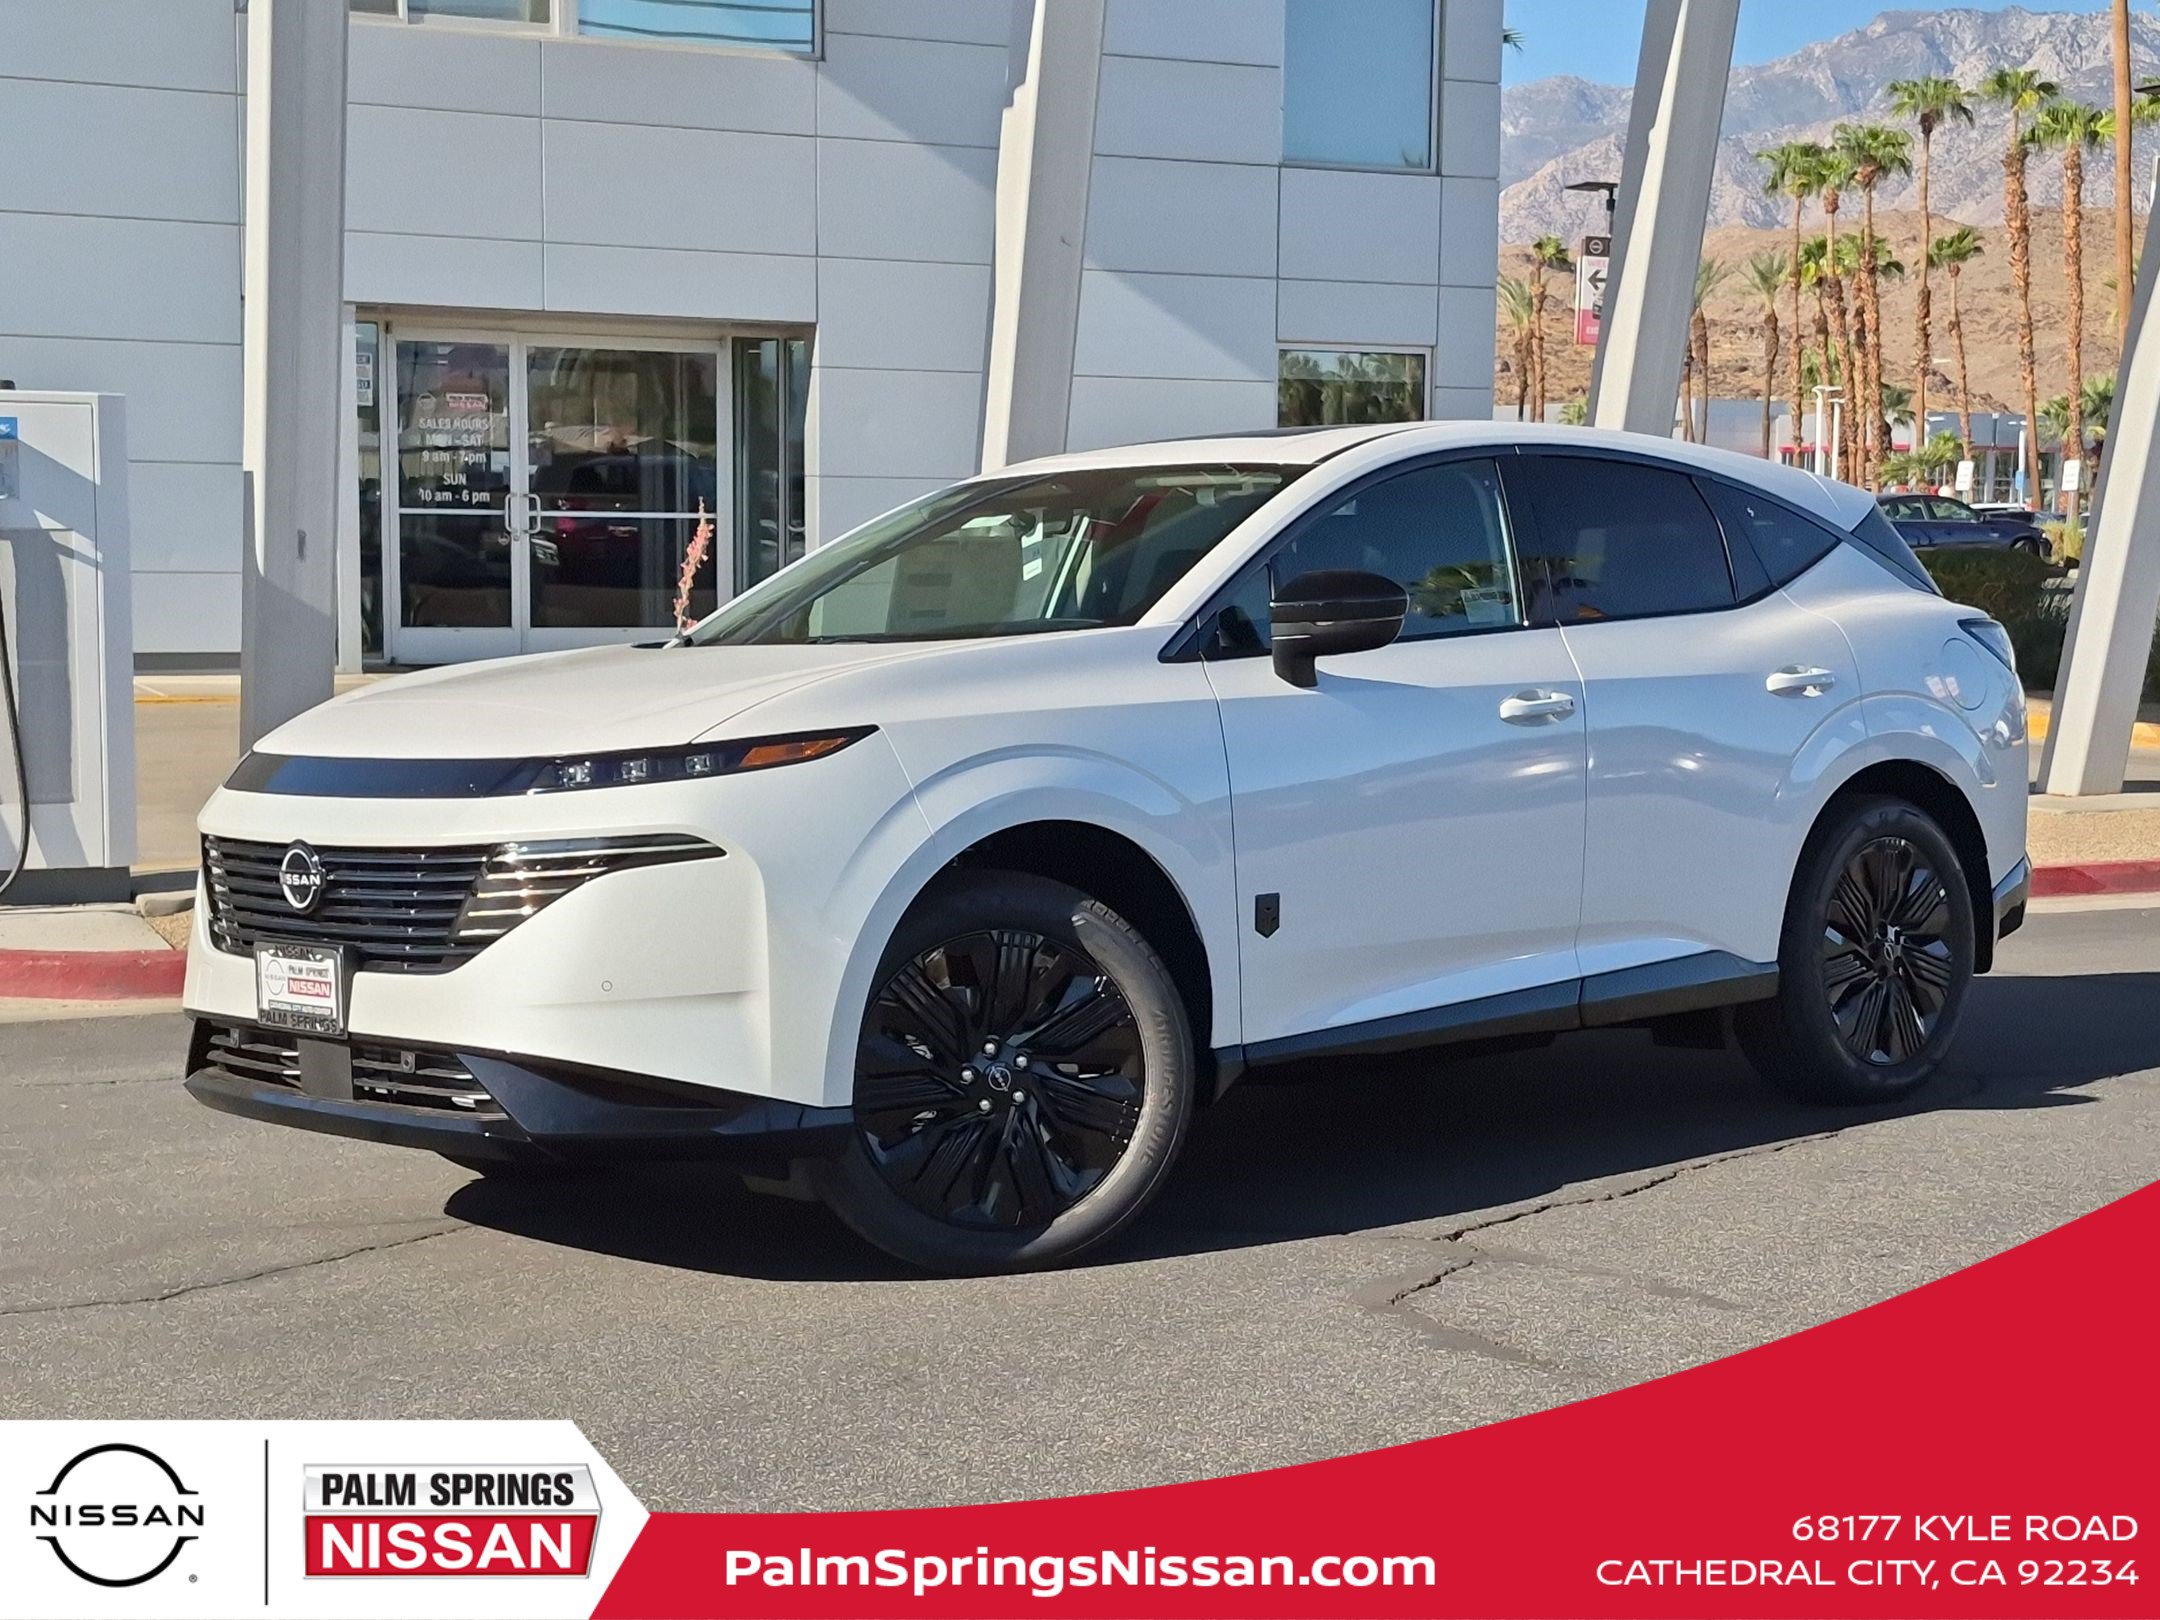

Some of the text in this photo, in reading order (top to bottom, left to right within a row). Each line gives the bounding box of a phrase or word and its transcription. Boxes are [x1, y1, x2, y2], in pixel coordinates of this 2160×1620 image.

[419, 417, 489, 430] SALES HOURS
[461, 432, 485, 447] SAT
[422, 450, 430, 462] 9
[433, 452, 450, 462] am
[468, 452, 487, 466] pm
[443, 472, 467, 485] SUN
[418, 488, 432, 502] 10
[435, 491, 452, 502] am
[462, 490, 470, 502] 6
[472, 491, 490, 505] pm
[280, 870, 321, 885] SSAN
[274, 944, 314, 960] NISSAN
[289, 979, 331, 997] NISSAN
[259, 1010, 338, 1033] PALM SPRINGS
[1140, 1010, 1174, 1167] ESTONE
